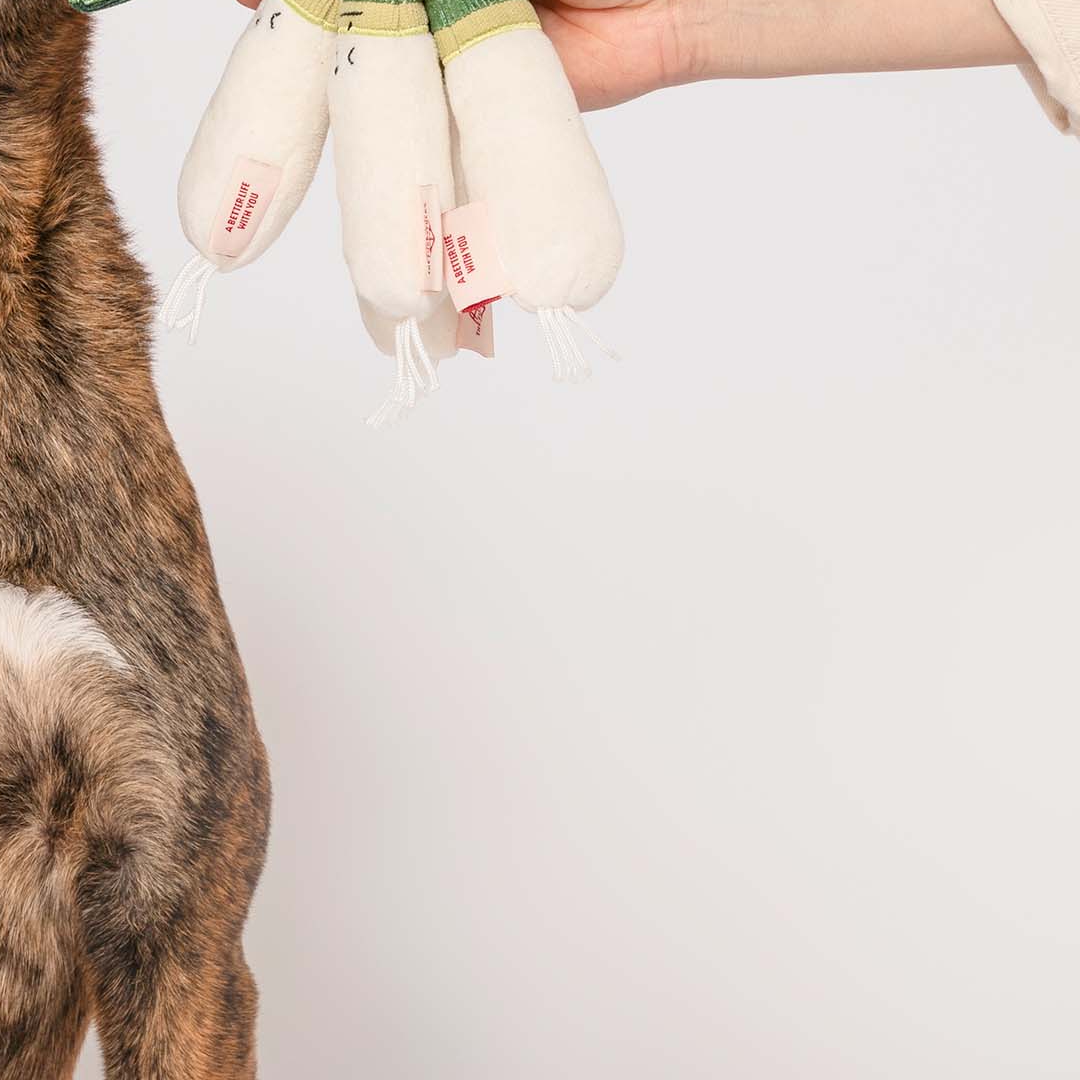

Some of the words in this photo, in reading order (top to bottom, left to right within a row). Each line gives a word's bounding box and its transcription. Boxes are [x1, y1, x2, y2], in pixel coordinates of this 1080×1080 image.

[227, 197, 244, 226] BETTER
[238, 181, 250, 198] LIFE
[237, 210, 252, 230] WITH
[246, 192, 259, 209] YOU
[443, 234, 455, 251] LIFE
[457, 235, 469, 253] YOU
[447, 249, 464, 279] BETTER
[462, 252, 476, 274] WITH
[457, 276, 466, 284] A
